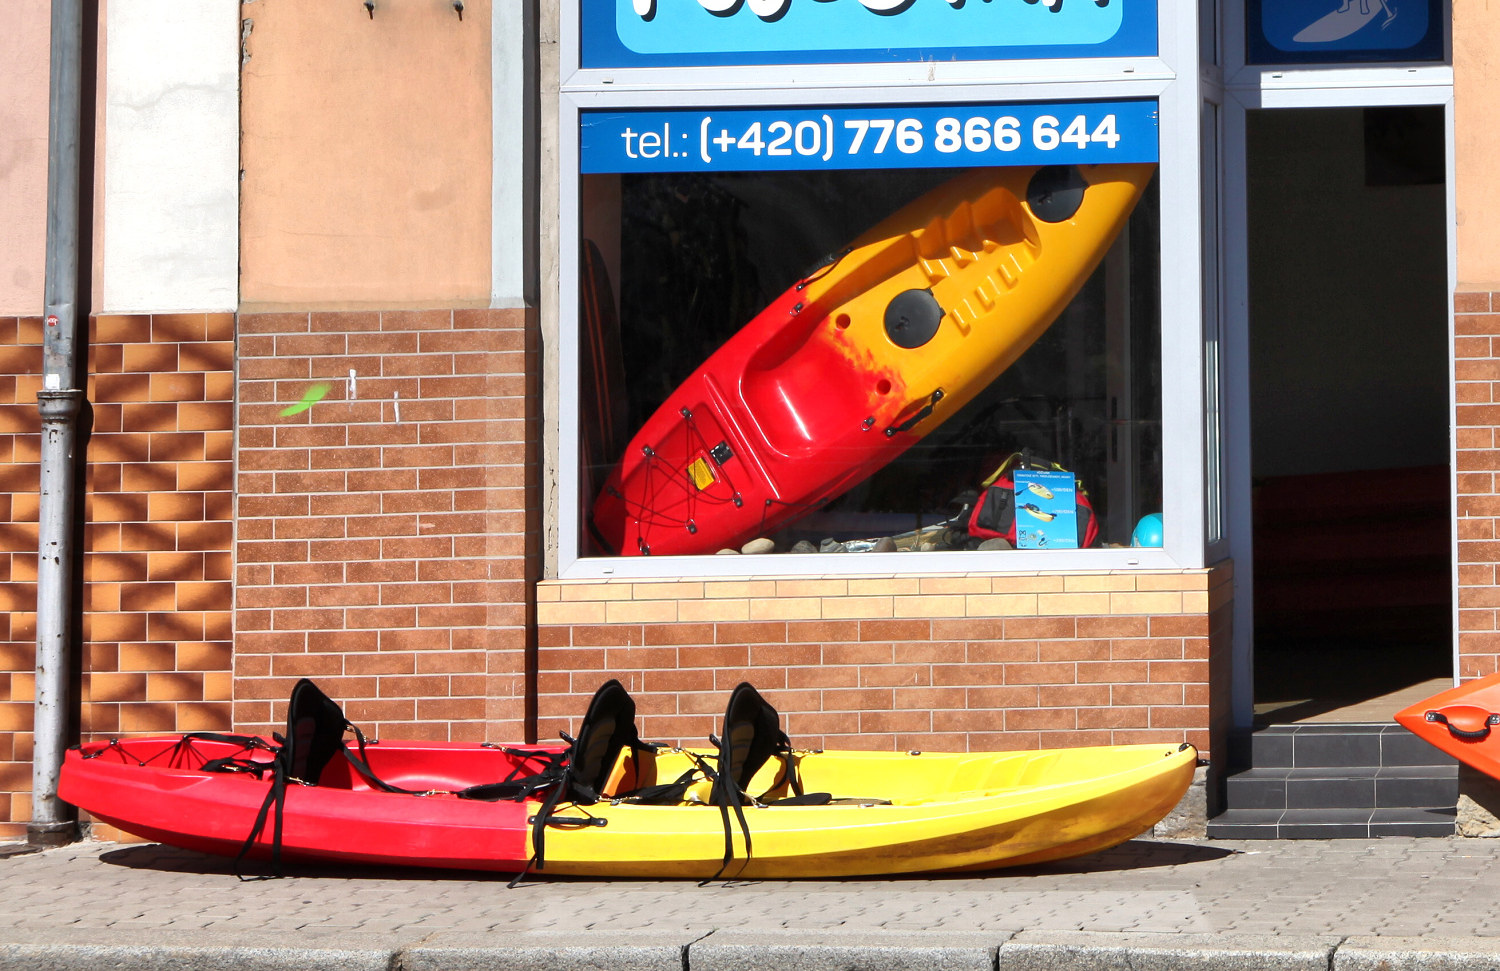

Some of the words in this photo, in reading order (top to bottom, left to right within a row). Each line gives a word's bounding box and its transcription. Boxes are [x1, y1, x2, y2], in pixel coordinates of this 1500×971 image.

[621, 122, 688, 159] tel.:
[700, 114, 833, 164] (+420)
[844, 118, 924, 155] 776
[935, 116, 1021, 153] 866
[1033, 114, 1120, 151] 644
